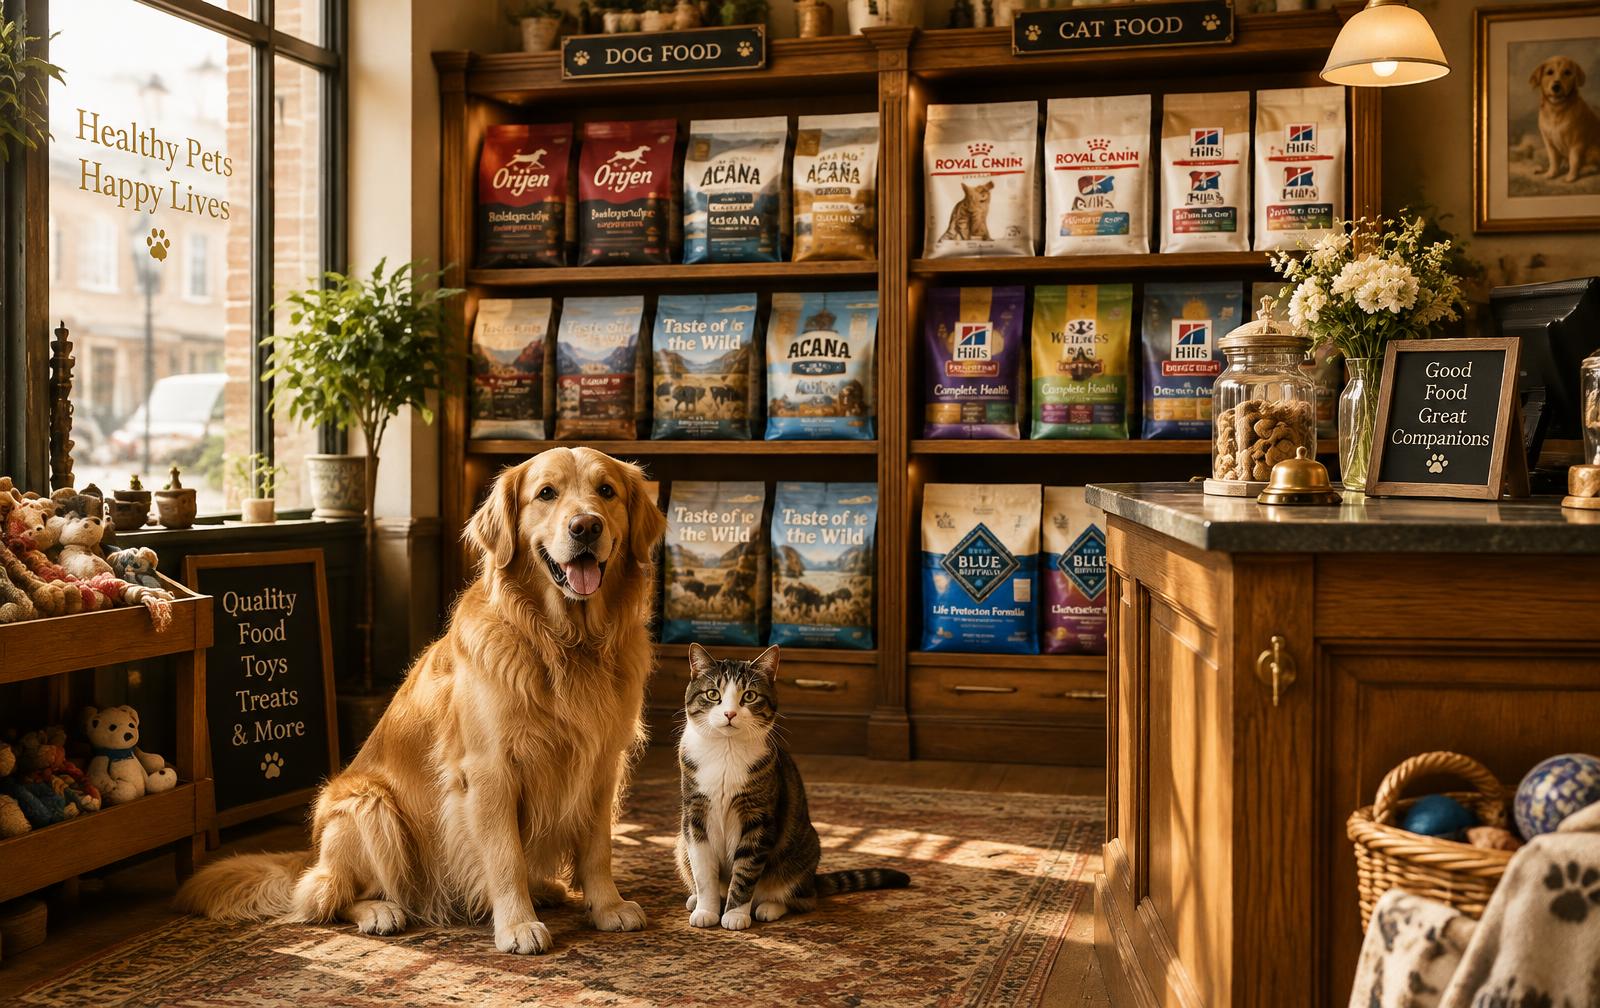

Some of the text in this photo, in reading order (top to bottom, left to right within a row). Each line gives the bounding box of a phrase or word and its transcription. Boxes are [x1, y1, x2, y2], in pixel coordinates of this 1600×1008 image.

[1058, 16, 1183, 40] CAT FOOD
[605, 43, 722, 65] DOG FOOD
[76, 108, 233, 177] Healthy Pets
[935, 158, 977, 170] ROYAL
[1055, 151, 1139, 164] ROYAL CANIN
[492, 167, 550, 196] Orijen
[593, 164, 653, 192] Orijen
[700, 162, 761, 187] ACANA
[78, 158, 230, 220] Happy Lives
[663, 318, 710, 334] Taste
[710, 319, 728, 333] of
[668, 335, 741, 351] the Wild
[787, 338, 851, 359] ACANA
[1425, 361, 1473, 378] Good
[1424, 383, 1468, 401] Food
[1418, 407, 1468, 424] Great
[1391, 428, 1490, 450] Companions
[674, 506, 718, 524] Taste
[720, 508, 740, 524] of
[782, 508, 828, 526] Taste
[831, 509, 851, 526] of
[679, 526, 751, 543] the Wild
[786, 527, 864, 546] the Wild
[958, 555, 1002, 569] BLUE
[223, 587, 297, 617] Quality
[932, 605, 949, 615] Life
[238, 619, 286, 645] Food
[241, 655, 288, 682] Toys
[235, 687, 299, 713] Treats
[232, 719, 305, 746] & More
